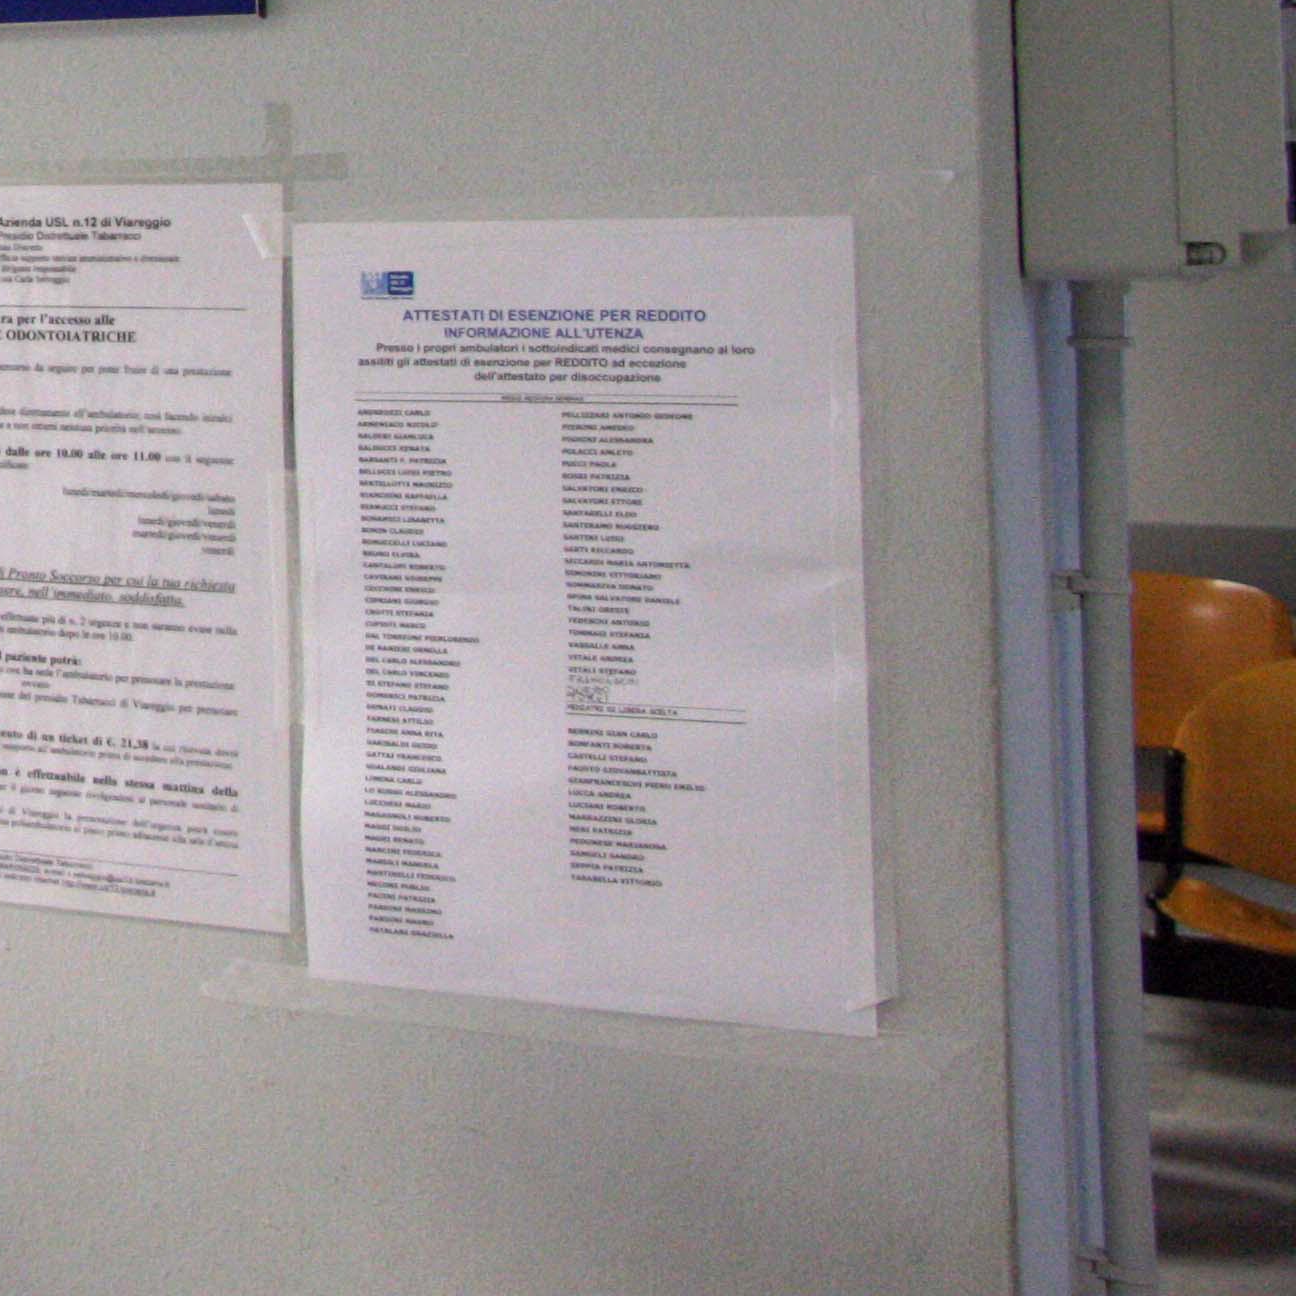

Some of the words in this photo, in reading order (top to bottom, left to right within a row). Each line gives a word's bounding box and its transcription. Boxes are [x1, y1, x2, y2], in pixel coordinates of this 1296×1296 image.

[45, 216, 67, 227] USL
[73, 216, 97, 227] n.12
[101, 217, 111, 227] di
[115, 217, 171, 229] Viareggio
[16, 316, 35, 326] per
[40, 313, 91, 325] l'accesso
[94, 314, 115, 325] alle
[403, 309, 484, 321] ATTESTATI
[489, 309, 503, 321] DI
[508, 309, 593, 321] ESENZIONE
[600, 309, 631, 321] PER
[636, 309, 706, 322] REDDITO
[6, 329, 136, 343] ODONTOIATRICHE
[444, 327, 550, 338] INFORMAZIONE
[556, 327, 643, 339] ALL'UTENZA
[376, 342, 414, 353] Presso
[423, 344, 457, 354] propri
[459, 343, 519, 353] ambulatori
[528, 344, 599, 353] sottoindicati
[601, 344, 640, 353] medici
[643, 346, 715, 356] consegnano
[731, 345, 755, 354] loro
[474, 371, 546, 381] dell'attestato
[549, 374, 567, 382] per
[571, 372, 661, 383] disoccupazione
